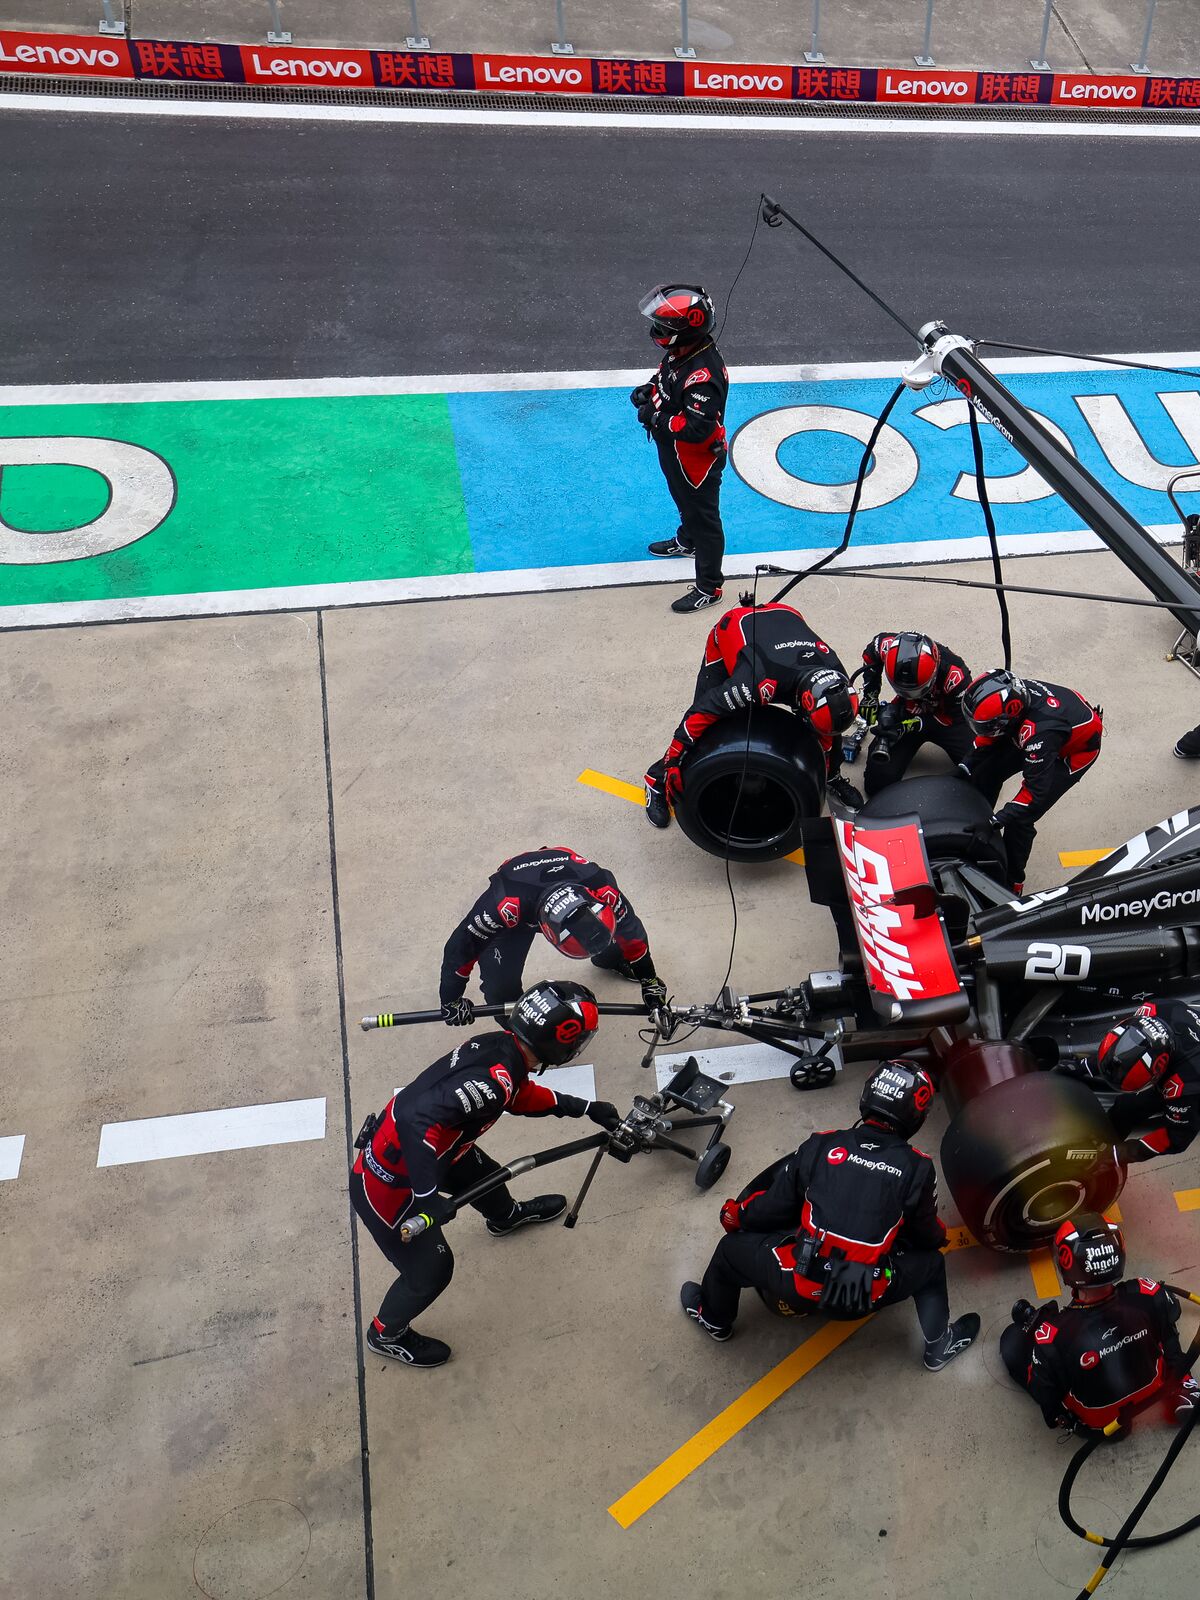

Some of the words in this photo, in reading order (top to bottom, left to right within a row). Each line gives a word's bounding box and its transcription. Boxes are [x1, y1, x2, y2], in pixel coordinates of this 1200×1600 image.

[0, 39, 120, 68] Lenovo
[135, 41, 221, 79] 联想
[252, 53, 362, 79] Lenovo
[377, 52, 455, 88] 联想
[484, 62, 583, 86] Lenovo
[598, 61, 667, 94] 联想
[693, 69, 784, 92] Lenovo
[798, 68, 861, 99] 联想
[884, 75, 969, 96] Lenovo
[981, 74, 1039, 102] 联想
[1059, 81, 1137, 100] Lenovo
[973, 395, 1014, 442] MoneyGram
[775, 640, 816, 650] MoneyGram
[513, 856, 569, 871] MoneyGram
[552, 892, 579, 915] Palm
[1024, 942, 1091, 980] 20
[518, 997, 547, 1026] Angels
[527, 989, 552, 1014] Palm
[472, 1079, 497, 1100] HAAS
[871, 1077, 905, 1099] Angels
[879, 1068, 907, 1087] Palm
[455, 1088, 472, 1114] PIRELLI
[847, 1153, 902, 1177] MoneyGram
[957, 1238, 970, 1247] 30
[1085, 1244, 1115, 1261] Palm
[1085, 1255, 1119, 1273] Angels
[1100, 1328, 1148, 1359] MoneyGram
